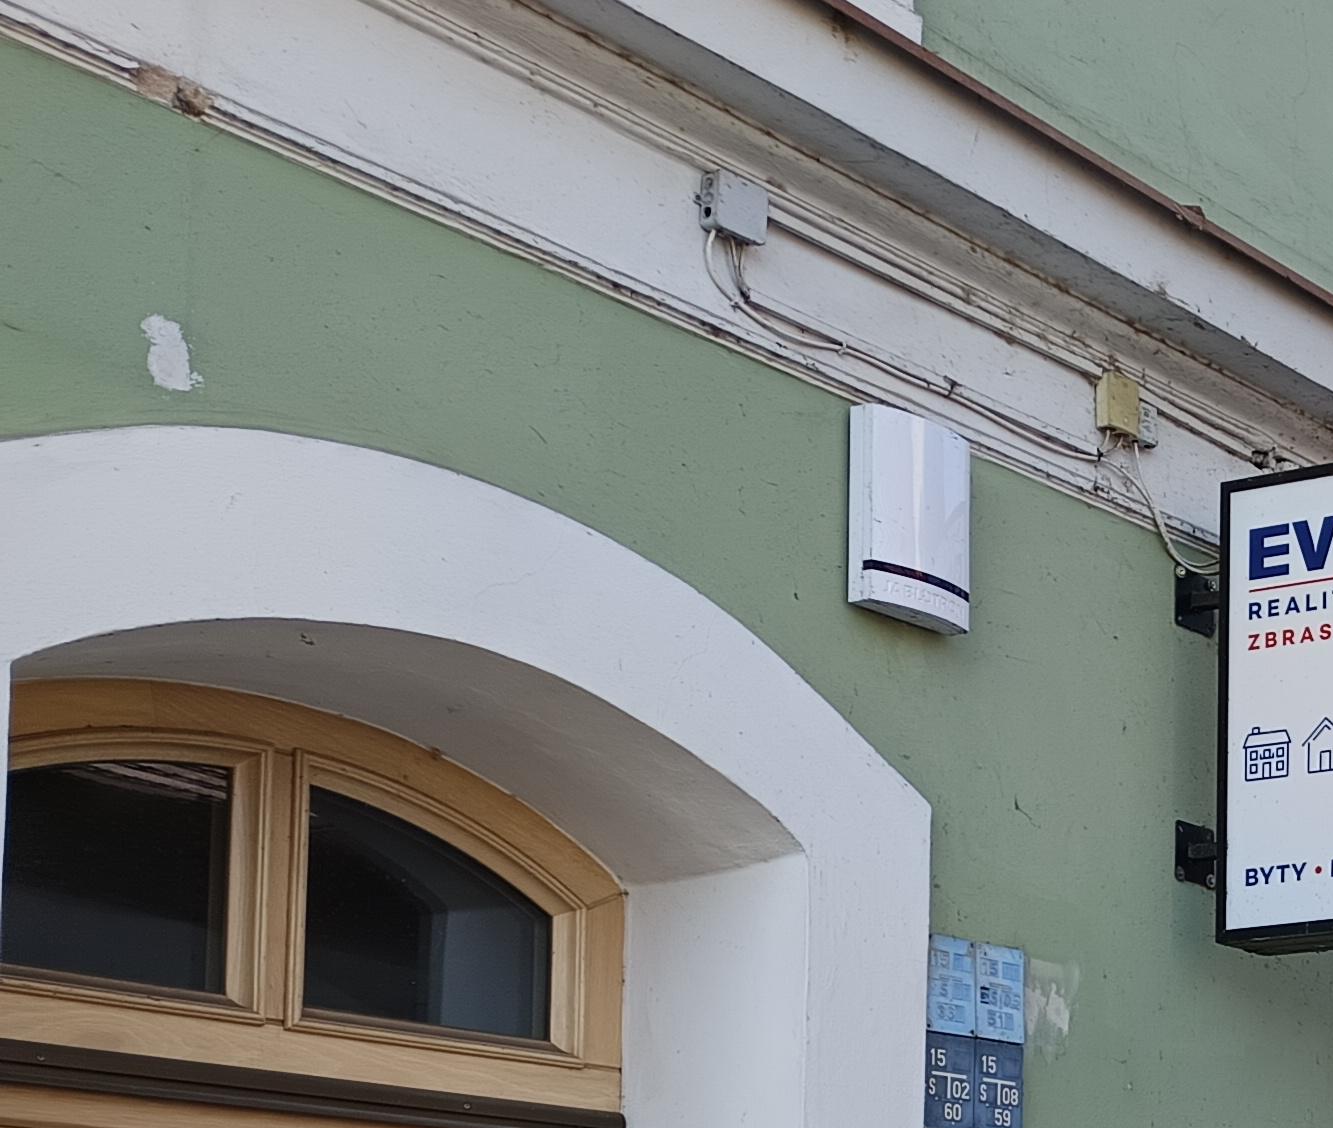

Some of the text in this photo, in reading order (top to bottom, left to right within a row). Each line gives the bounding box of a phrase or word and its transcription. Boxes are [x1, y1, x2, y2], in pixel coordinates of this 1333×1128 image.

[1244, 861, 1307, 887] BYTY
[930, 1048, 946, 1067] 15
[981, 1055, 997, 1074] 15
[928, 1077, 970, 1100] S 02
[980, 1083, 1019, 1106] S 08
[944, 1102, 962, 1121] 60
[994, 1108, 1011, 1127] 59
